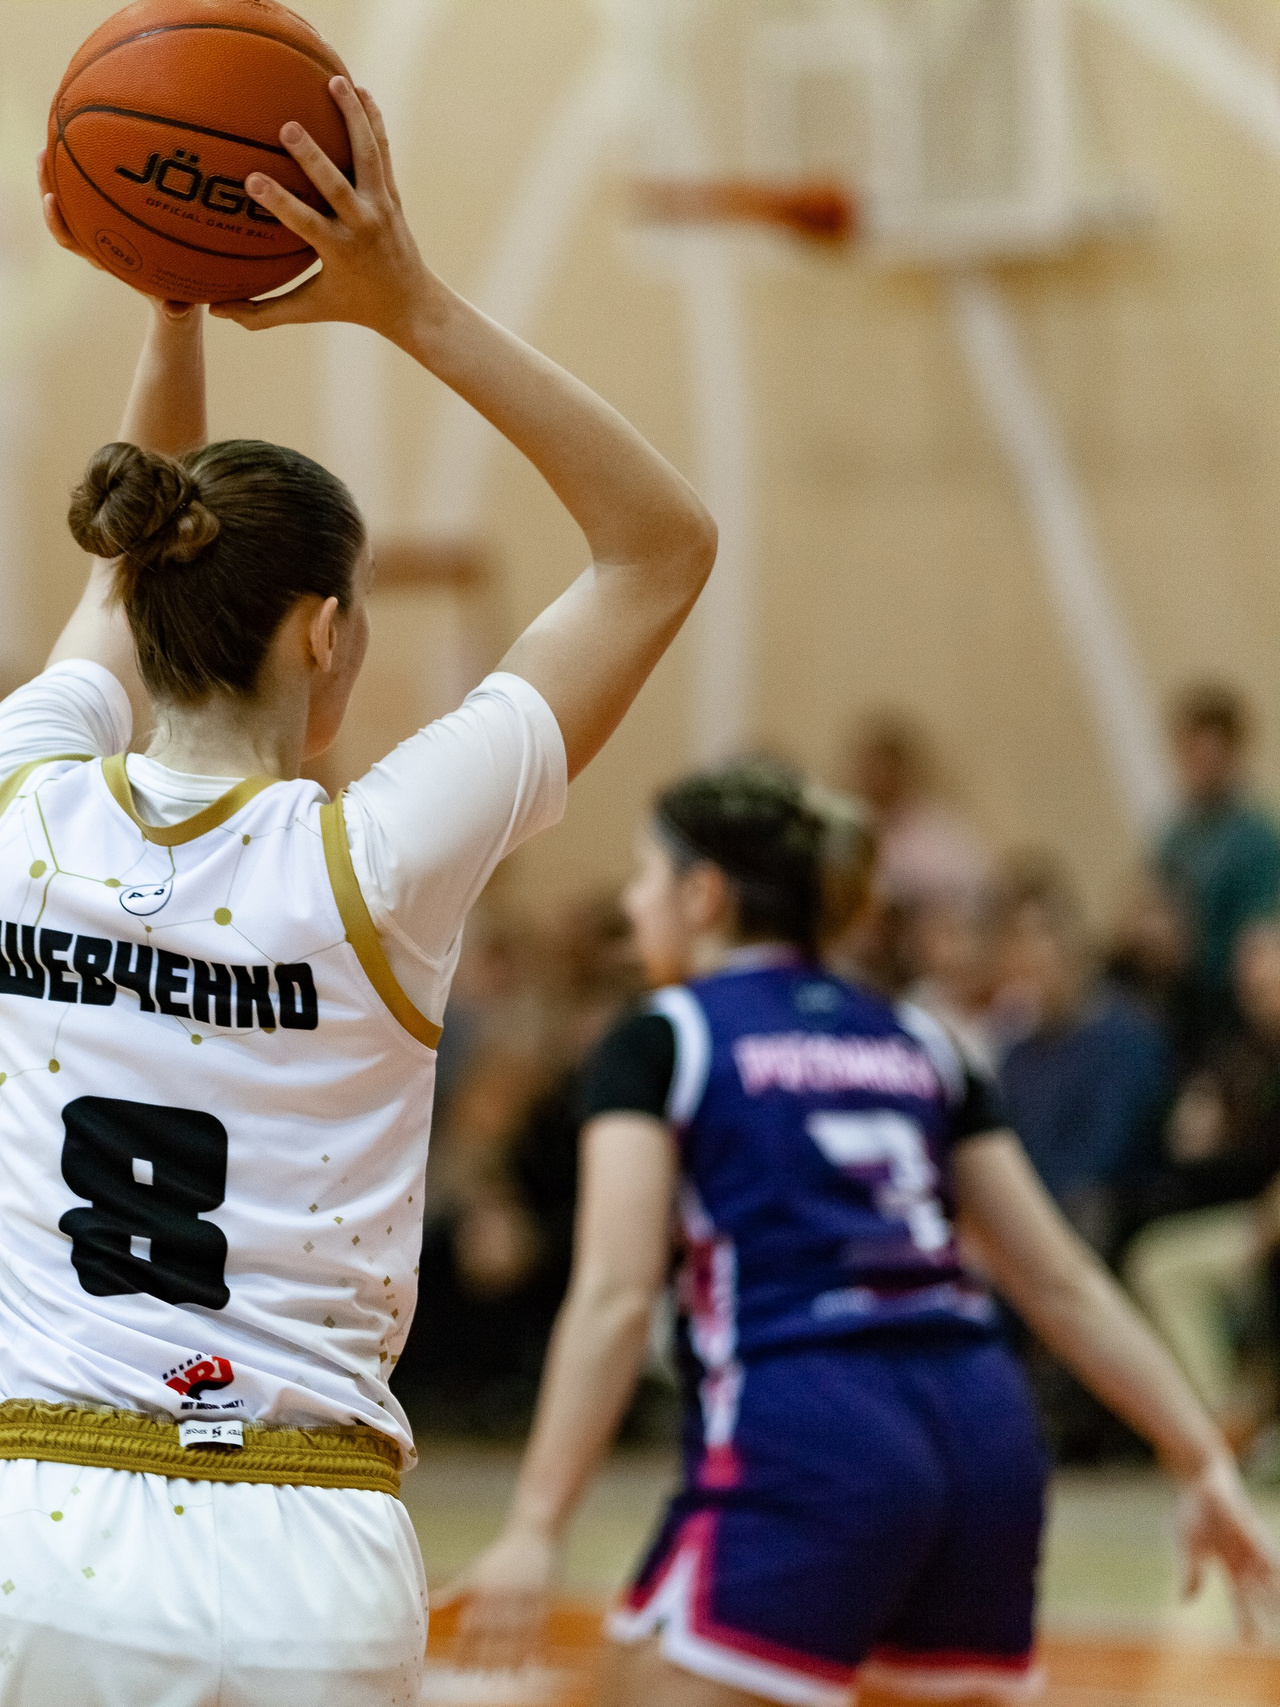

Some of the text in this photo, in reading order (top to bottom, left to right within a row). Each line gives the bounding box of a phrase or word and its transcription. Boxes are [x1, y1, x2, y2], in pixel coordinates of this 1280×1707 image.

[145, 197, 276, 241] OFFICIAL GAME BALL
[58, 1095, 231, 1311] 8
